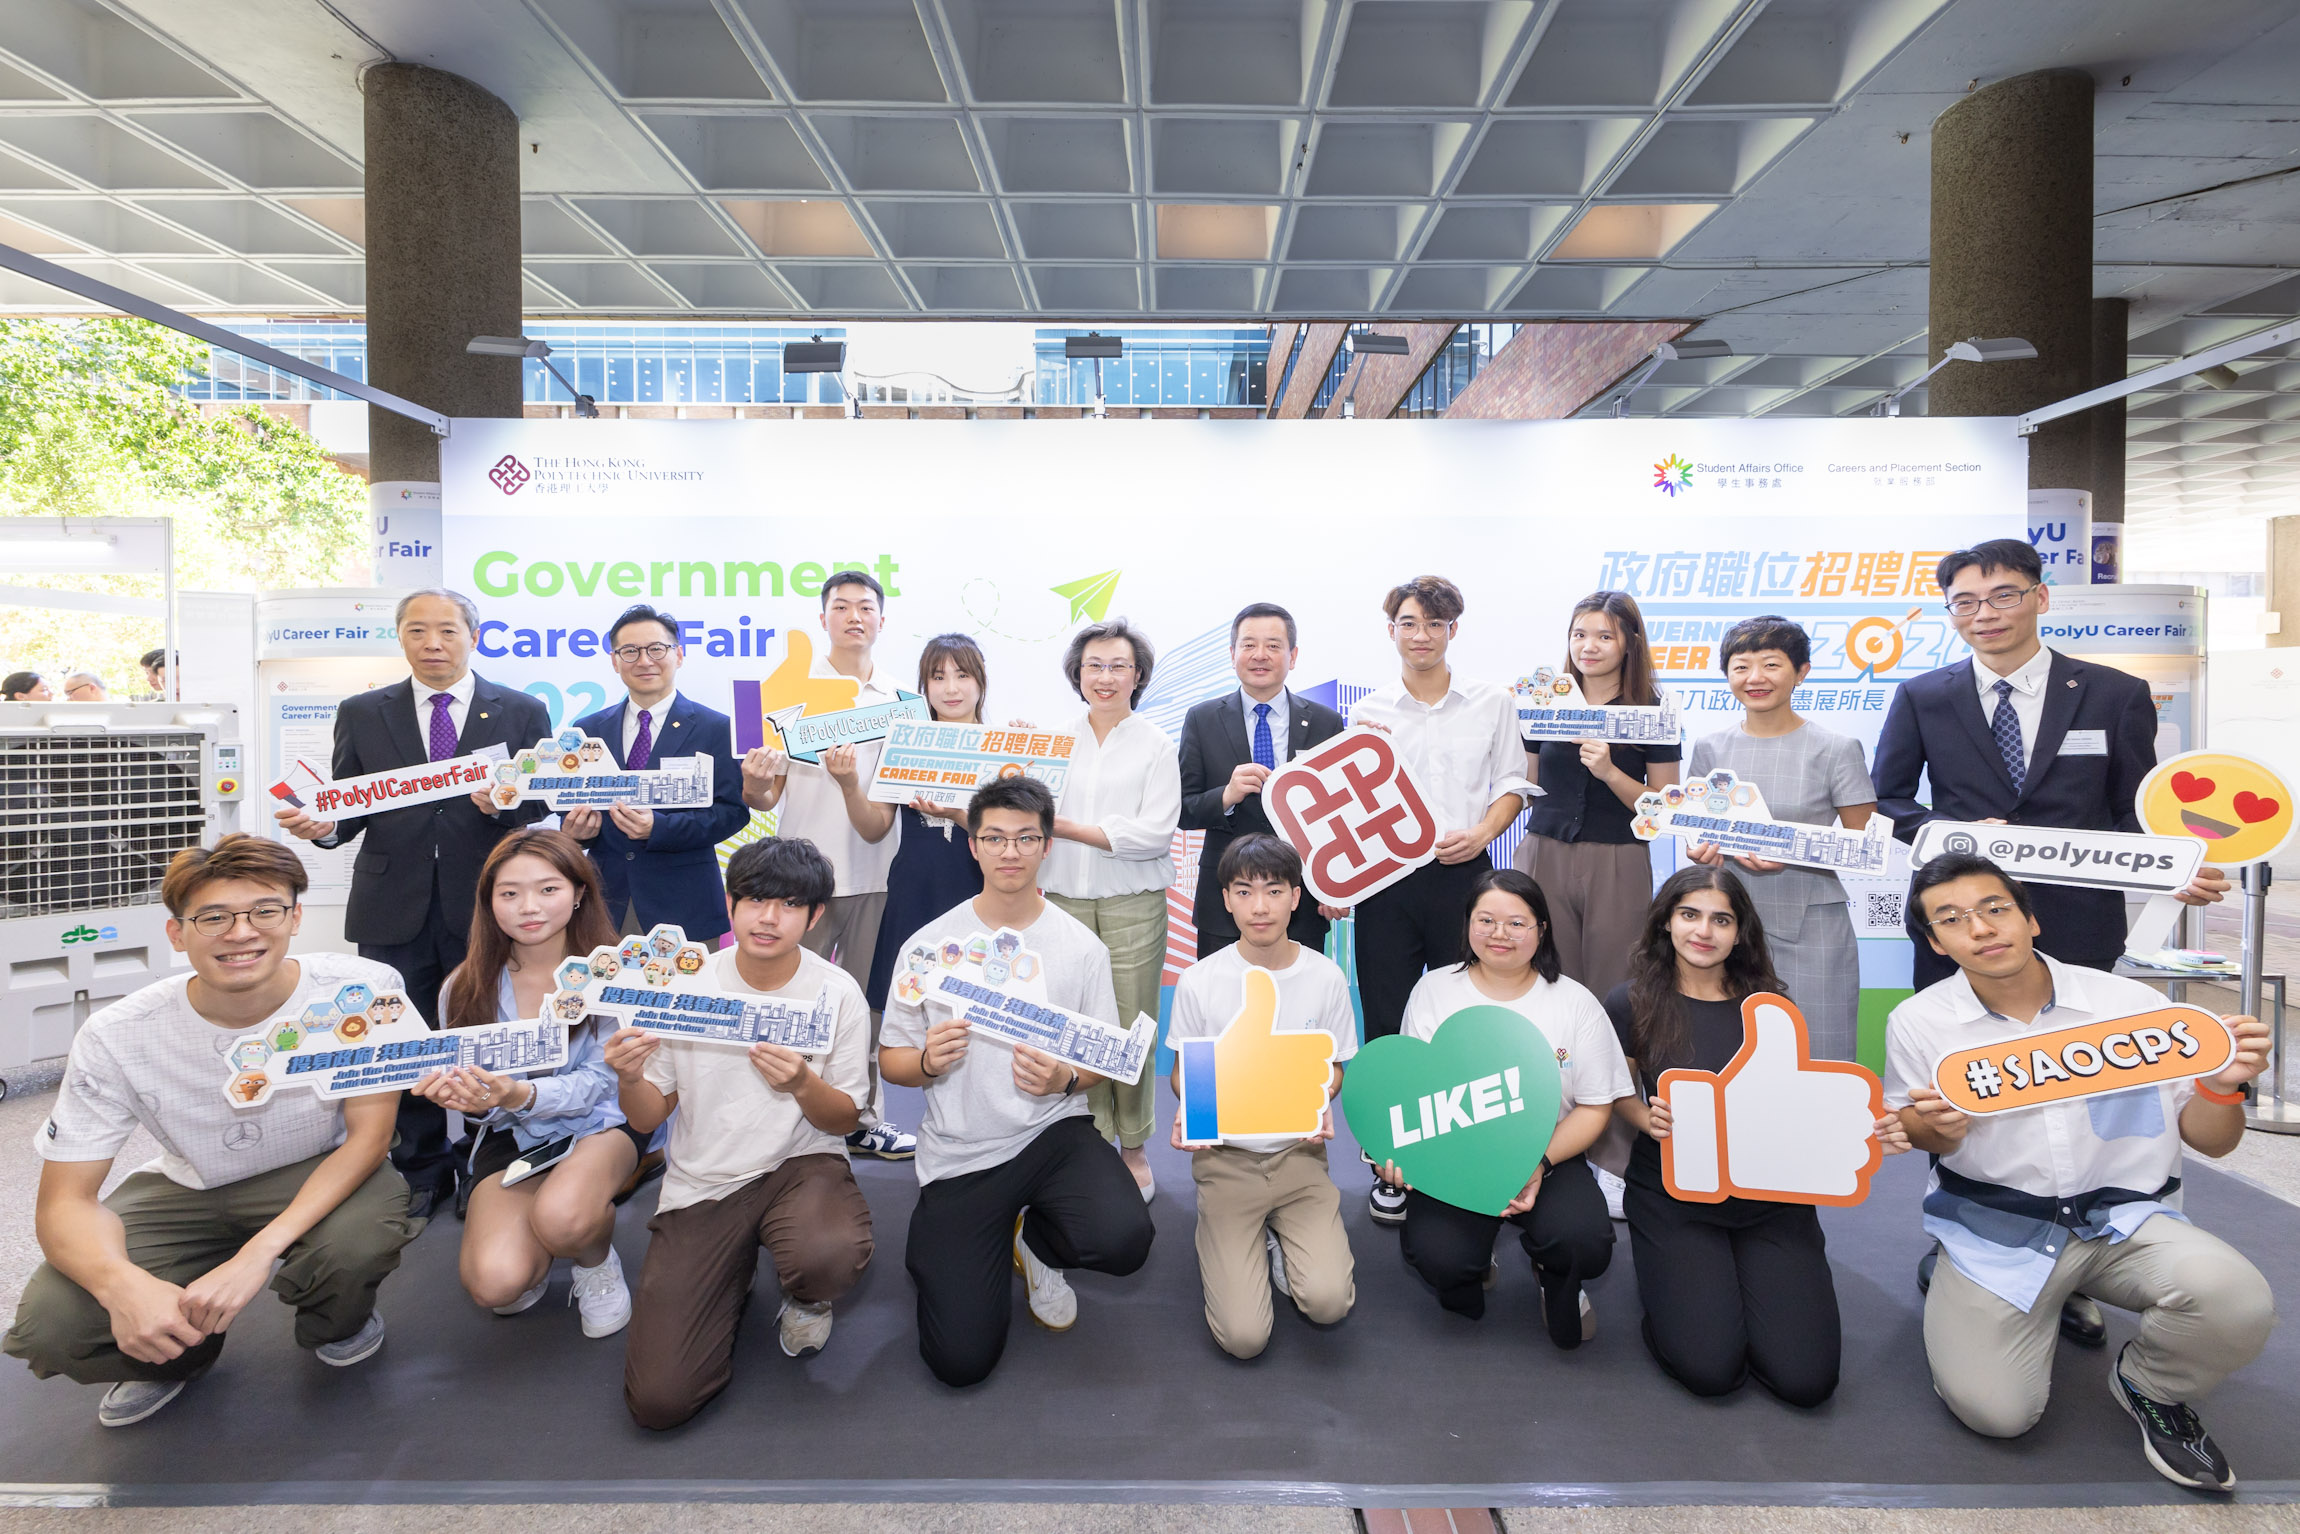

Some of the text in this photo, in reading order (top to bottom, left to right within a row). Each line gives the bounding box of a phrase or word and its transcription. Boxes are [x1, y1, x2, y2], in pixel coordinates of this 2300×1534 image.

[533, 456, 559, 468] THE
[608, 456, 645, 468] KONG
[1696, 463, 1804, 473] Student Affairs Office
[1828, 462, 1982, 473] Careers and Placement Section
[628, 470, 705, 481] UNIVERSITY
[388, 540, 432, 557] Fair
[282, 628, 331, 640] Career
[335, 626, 370, 639] Fair
[677, 615, 775, 658] Fair
[2040, 625, 2099, 639] PolyU
[2103, 624, 2161, 636] Career
[2164, 624, 2187, 637] Fair
[281, 704, 338, 712] Government
[281, 712, 312, 720] Career
[799, 706, 917, 745] #PolyUCareerFair
[889, 723, 1076, 759] 政府職位招聘展覽
[315, 761, 489, 813] #PolyUCareerFair
[879, 767, 978, 786] CAREER FAIR
[1988, 839, 2174, 873] @polyucps
[599, 986, 747, 1017] 投身政府 共建未來
[938, 975, 1069, 1030] 投身政府 共建未來
[286, 1035, 462, 1075] 投身政府 共建未來
[1965, 1020, 2200, 1100] #SAOCPS
[1389, 1065, 1525, 1149] LIKE!
